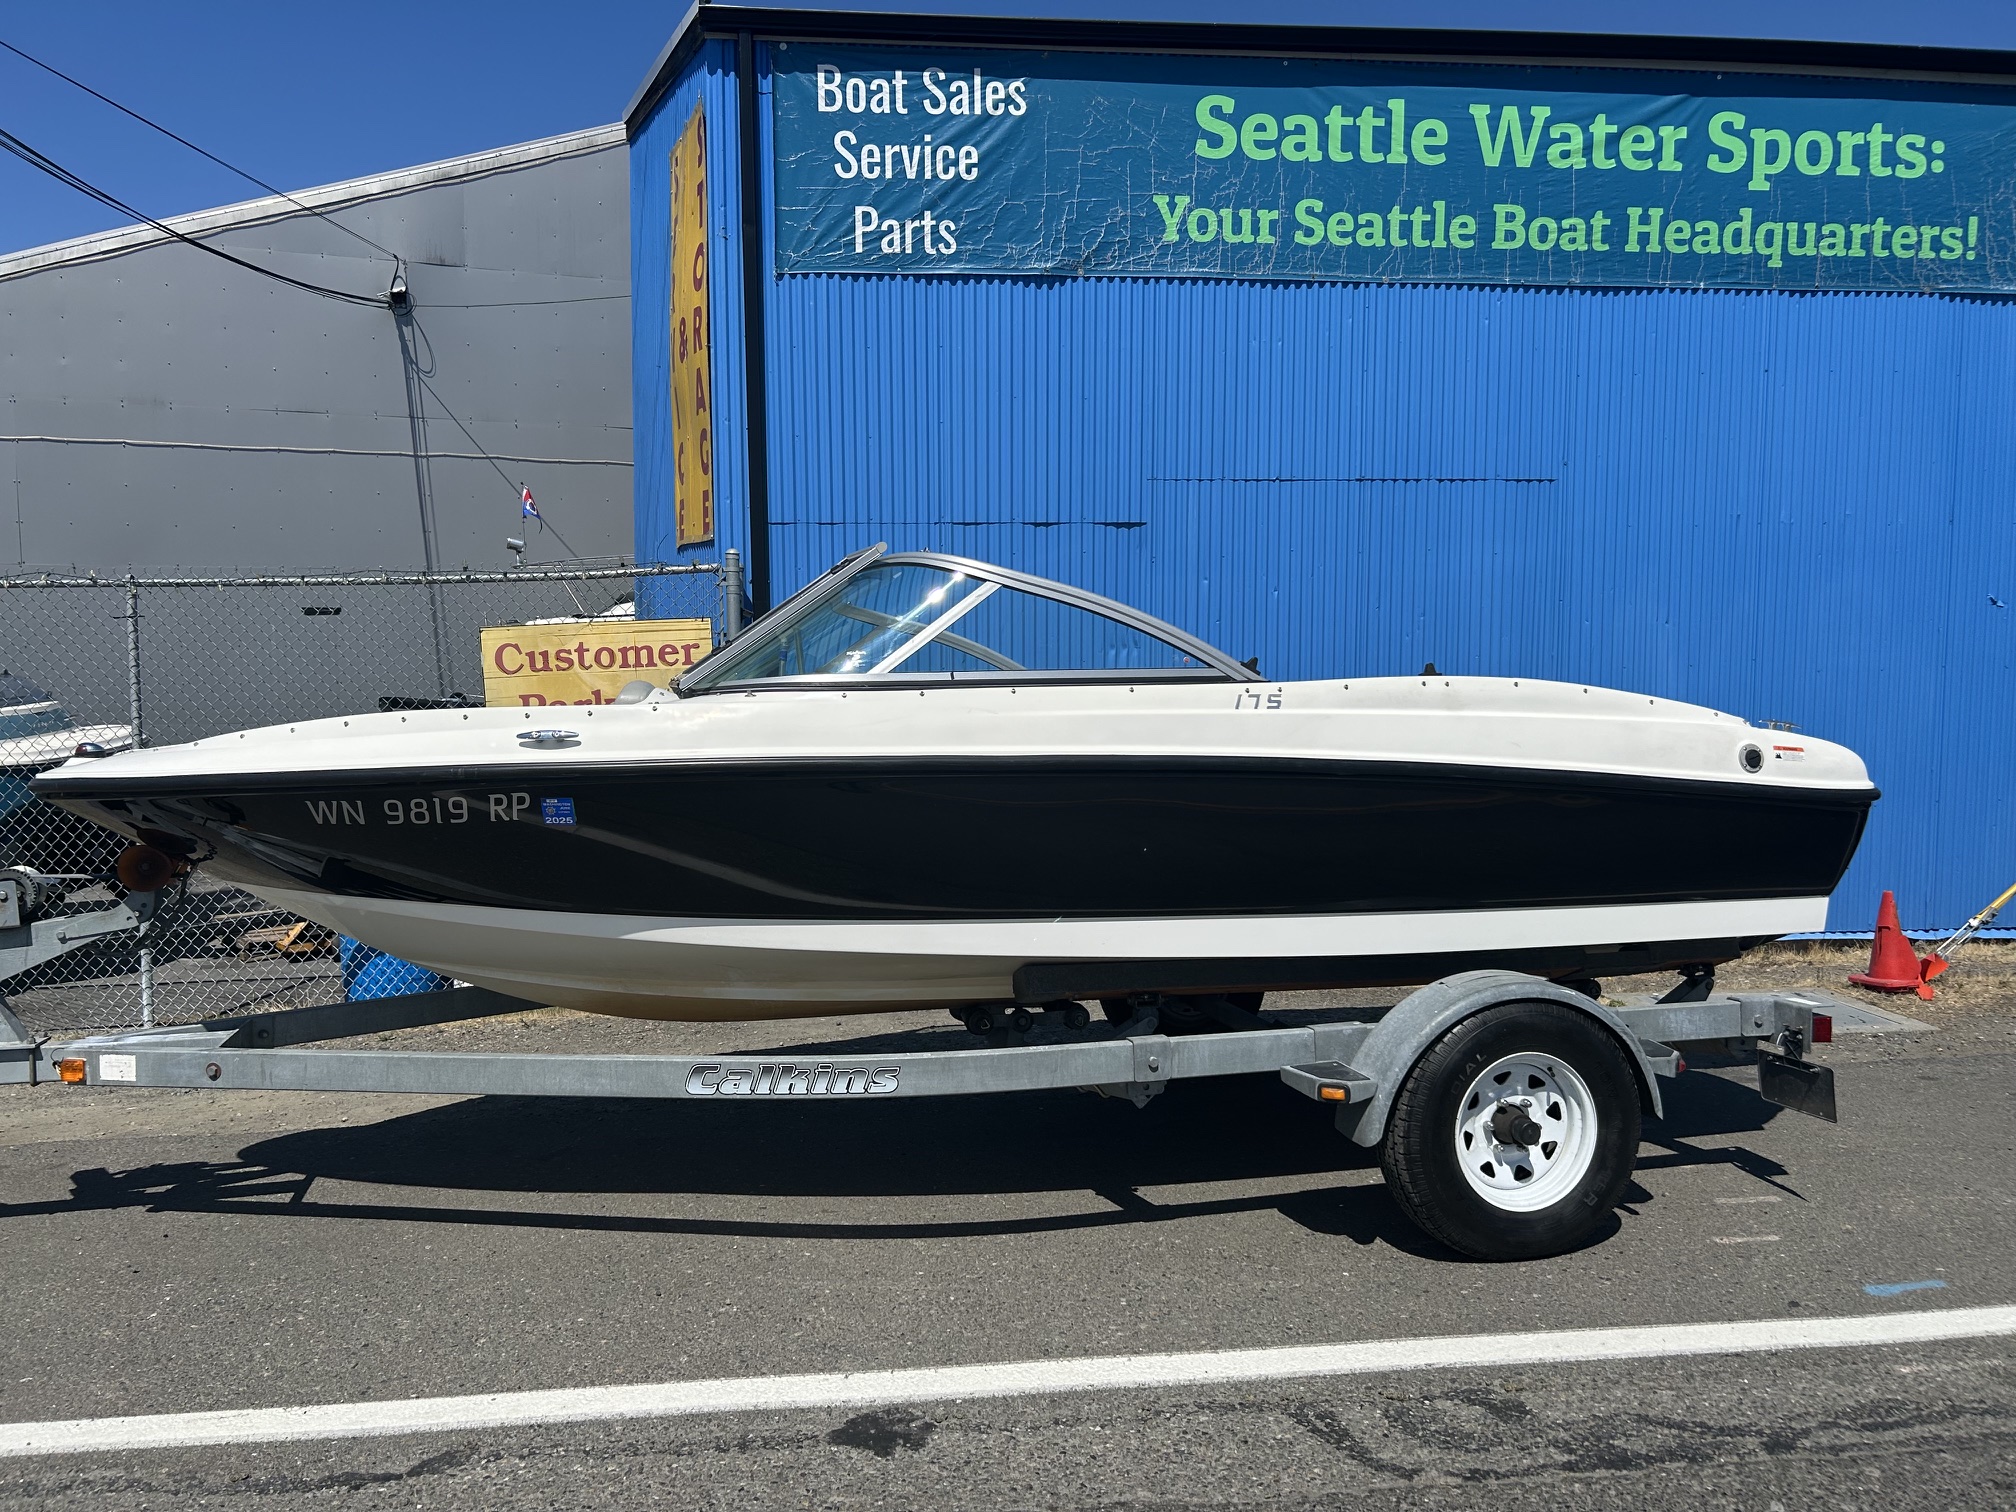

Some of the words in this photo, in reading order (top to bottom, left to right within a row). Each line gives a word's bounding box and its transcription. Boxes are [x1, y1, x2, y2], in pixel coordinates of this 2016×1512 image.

[817, 64, 907, 114] Boat
[922, 67, 1027, 116] Sales
[834, 131, 978, 181] Service
[1195, 95, 1448, 166] Seattle
[1469, 104, 1687, 172] Water
[1707, 111, 1945, 191] Sports:
[854, 206, 957, 255] Parts
[1153, 195, 1279, 244] Your
[1294, 199, 1476, 249] Seattle
[1492, 204, 1610, 252] Boat
[1625, 206, 1978, 268] Headquarters!
[679, 316, 688, 364] &
[692, 116, 710, 536] STORAGE
[494, 641, 700, 675] Customer
[1235, 694, 1282, 709] 175
[305, 800, 366, 825] WN
[383, 796, 469, 825] 9819
[487, 792, 531, 822] RP
[545, 816, 574, 824] 2025
[685, 1063, 901, 1095] Calkins
